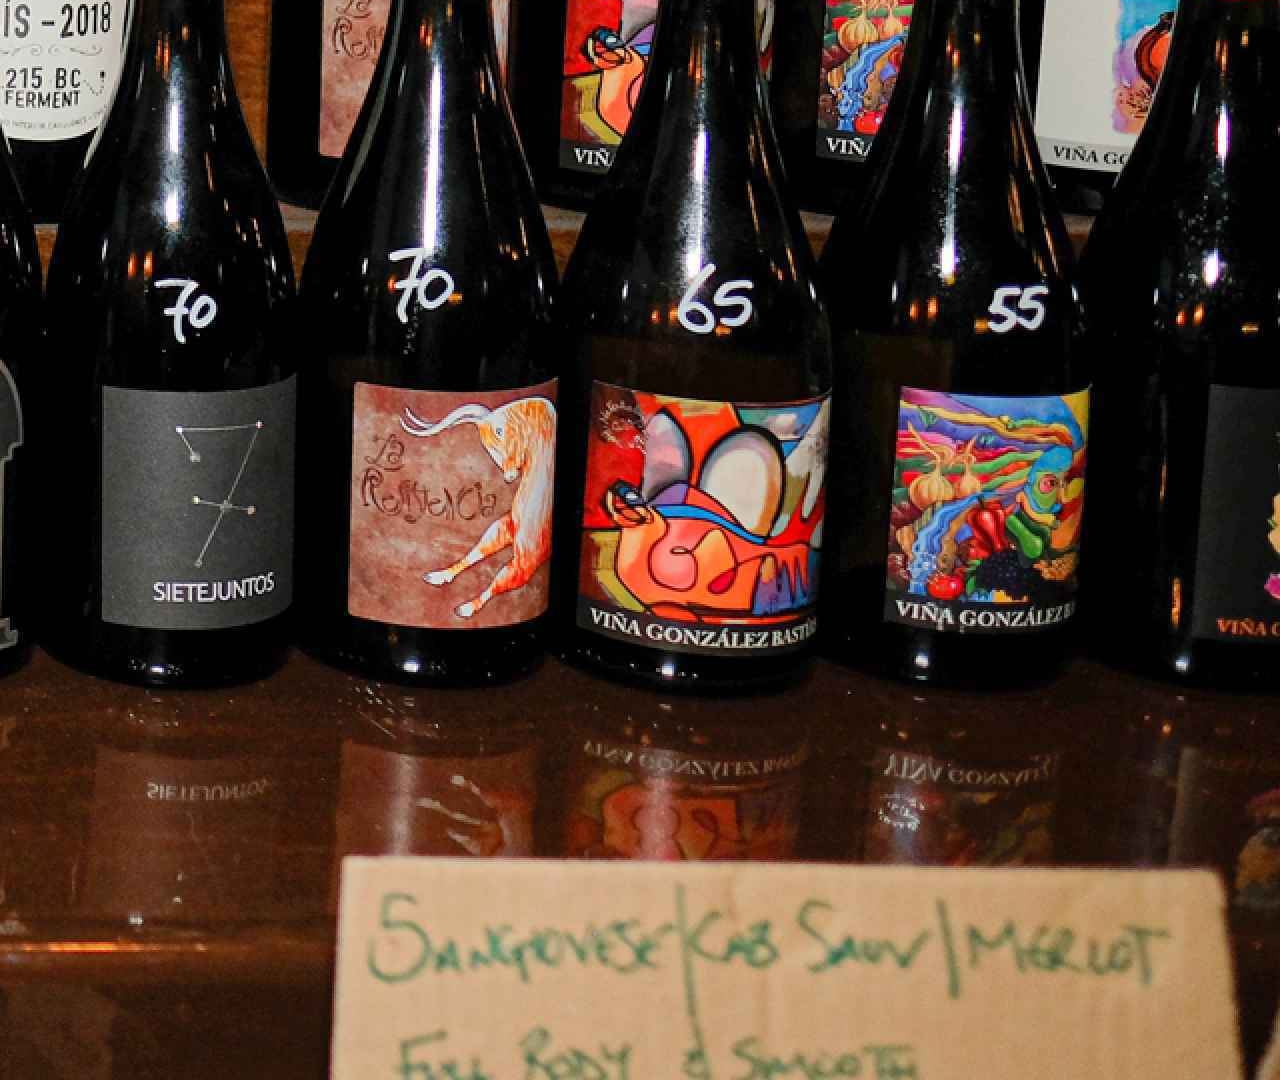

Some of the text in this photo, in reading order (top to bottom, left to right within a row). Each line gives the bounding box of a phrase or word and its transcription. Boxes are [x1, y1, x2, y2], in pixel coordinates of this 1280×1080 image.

[5, 67, 82, 89] 215 BC
[5, 89, 81, 109] FERMENT
[1052, 144, 1098, 166] VIÑA
[389, 248, 455, 323] 70
[678, 261, 755, 335] 65
[154, 278, 217, 345] 70
[987, 284, 1049, 333] 55
[152, 570, 275, 603] SIETEJUNTOS
[590, 606, 643, 637] VIÑA
[645, 623, 770, 649] GONZÁLEZ
[895, 599, 1065, 628] VIÑA GONZÁLEZ
[1216, 618, 1267, 637] VIÑA
